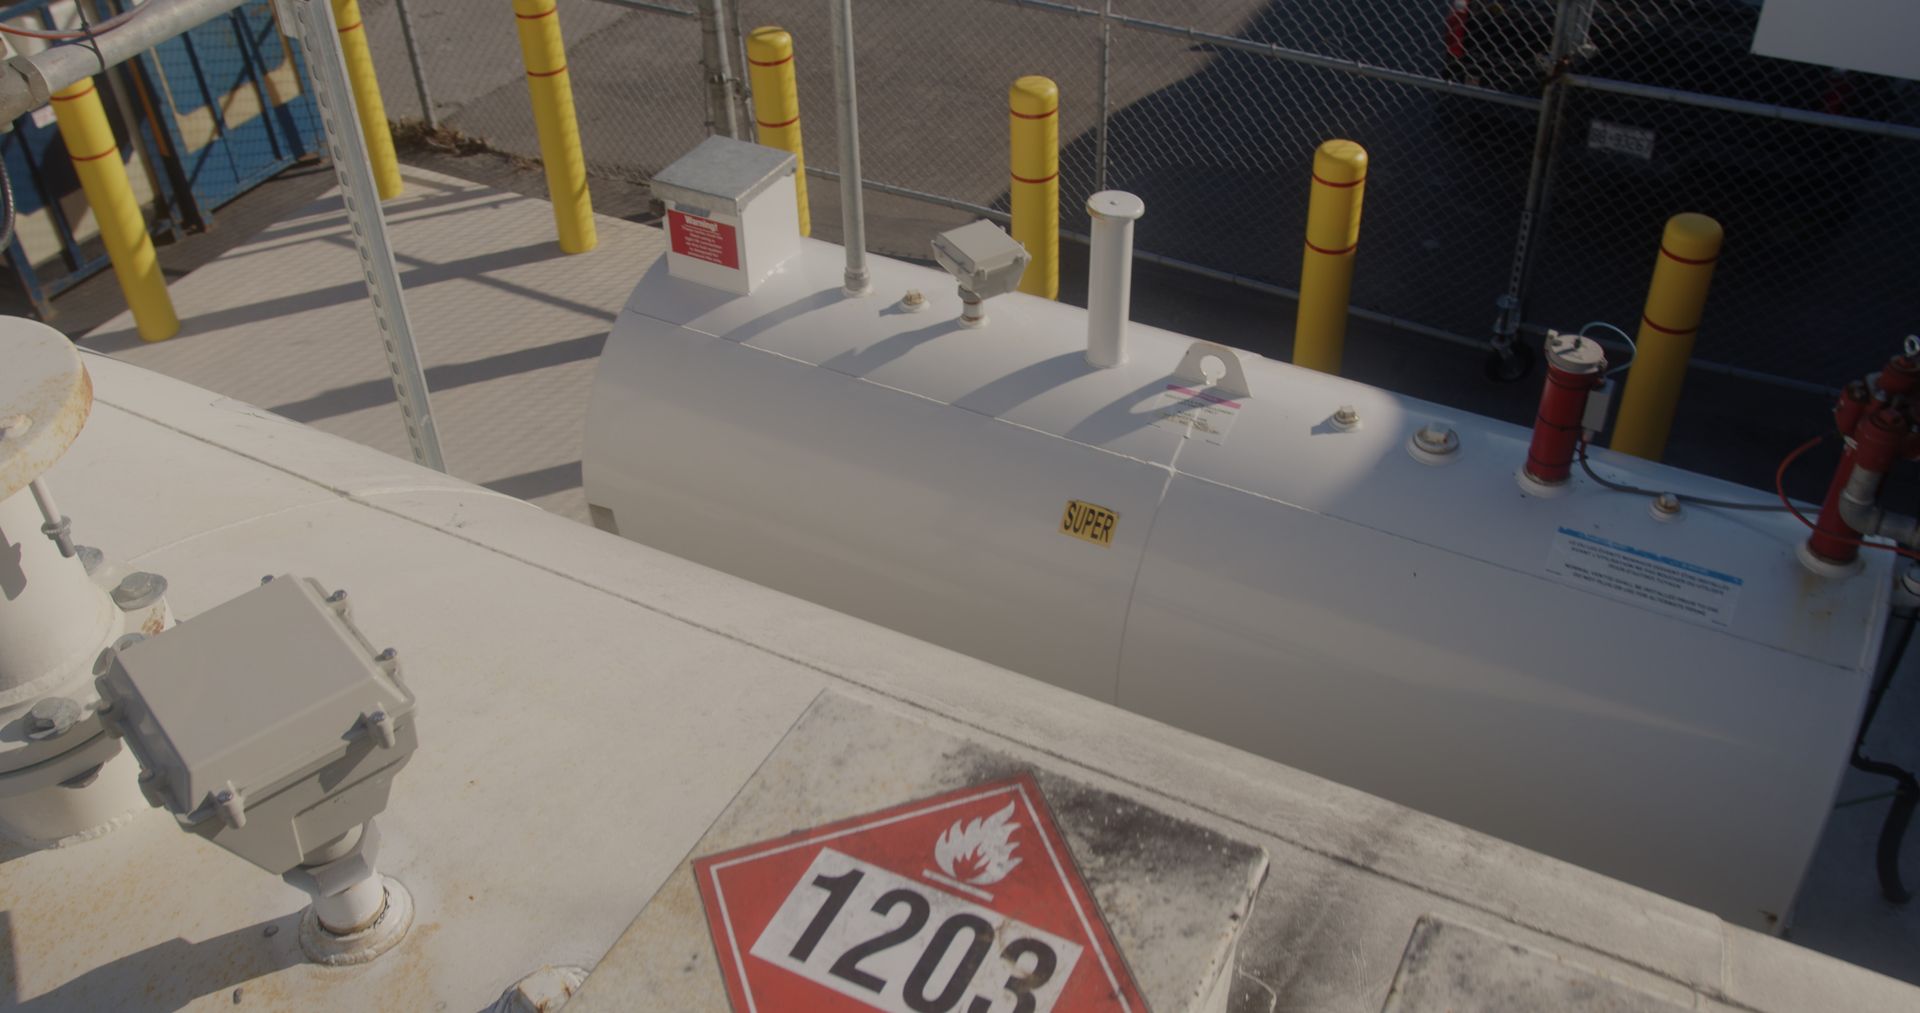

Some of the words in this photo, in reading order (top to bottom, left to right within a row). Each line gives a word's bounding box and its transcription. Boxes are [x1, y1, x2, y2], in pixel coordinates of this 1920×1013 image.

[684, 215, 718, 232] Warning!
[1064, 502, 1114, 543] SUPER
[789, 868, 1057, 1013] 1203
